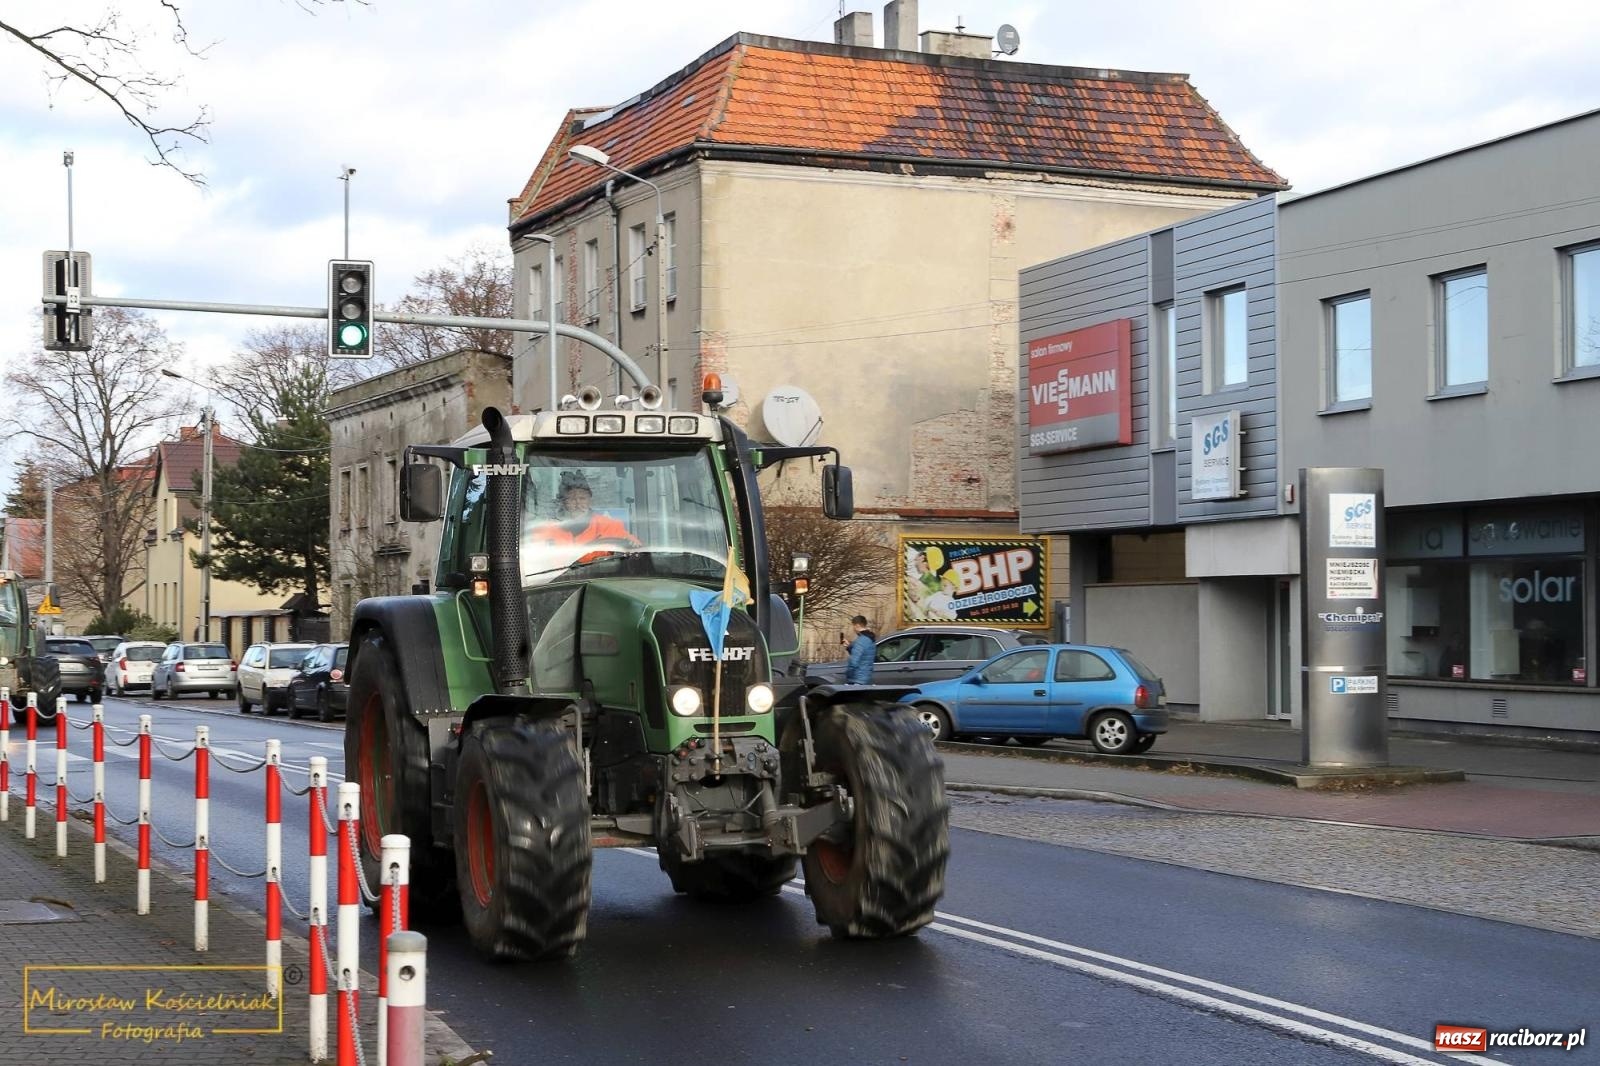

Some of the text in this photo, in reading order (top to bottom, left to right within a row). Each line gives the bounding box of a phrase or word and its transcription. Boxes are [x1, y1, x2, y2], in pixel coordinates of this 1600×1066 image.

[1030, 340, 1073, 359] salon firmowy
[1031, 368, 1117, 415] VIESSMANN
[1030, 427, 1078, 447] SGS-SERVICE
[1203, 418, 1229, 455] SGS
[472, 464, 530, 476] FENDT
[1203, 456, 1229, 468] SERVICE
[1344, 499, 1372, 521] SGS
[951, 549, 1032, 595] BHP
[948, 592, 985, 610] ODZIEŻ
[987, 585, 1036, 602] ROBOCZA
[1499, 570, 1576, 603] solar
[1333, 679, 1344, 692] P
